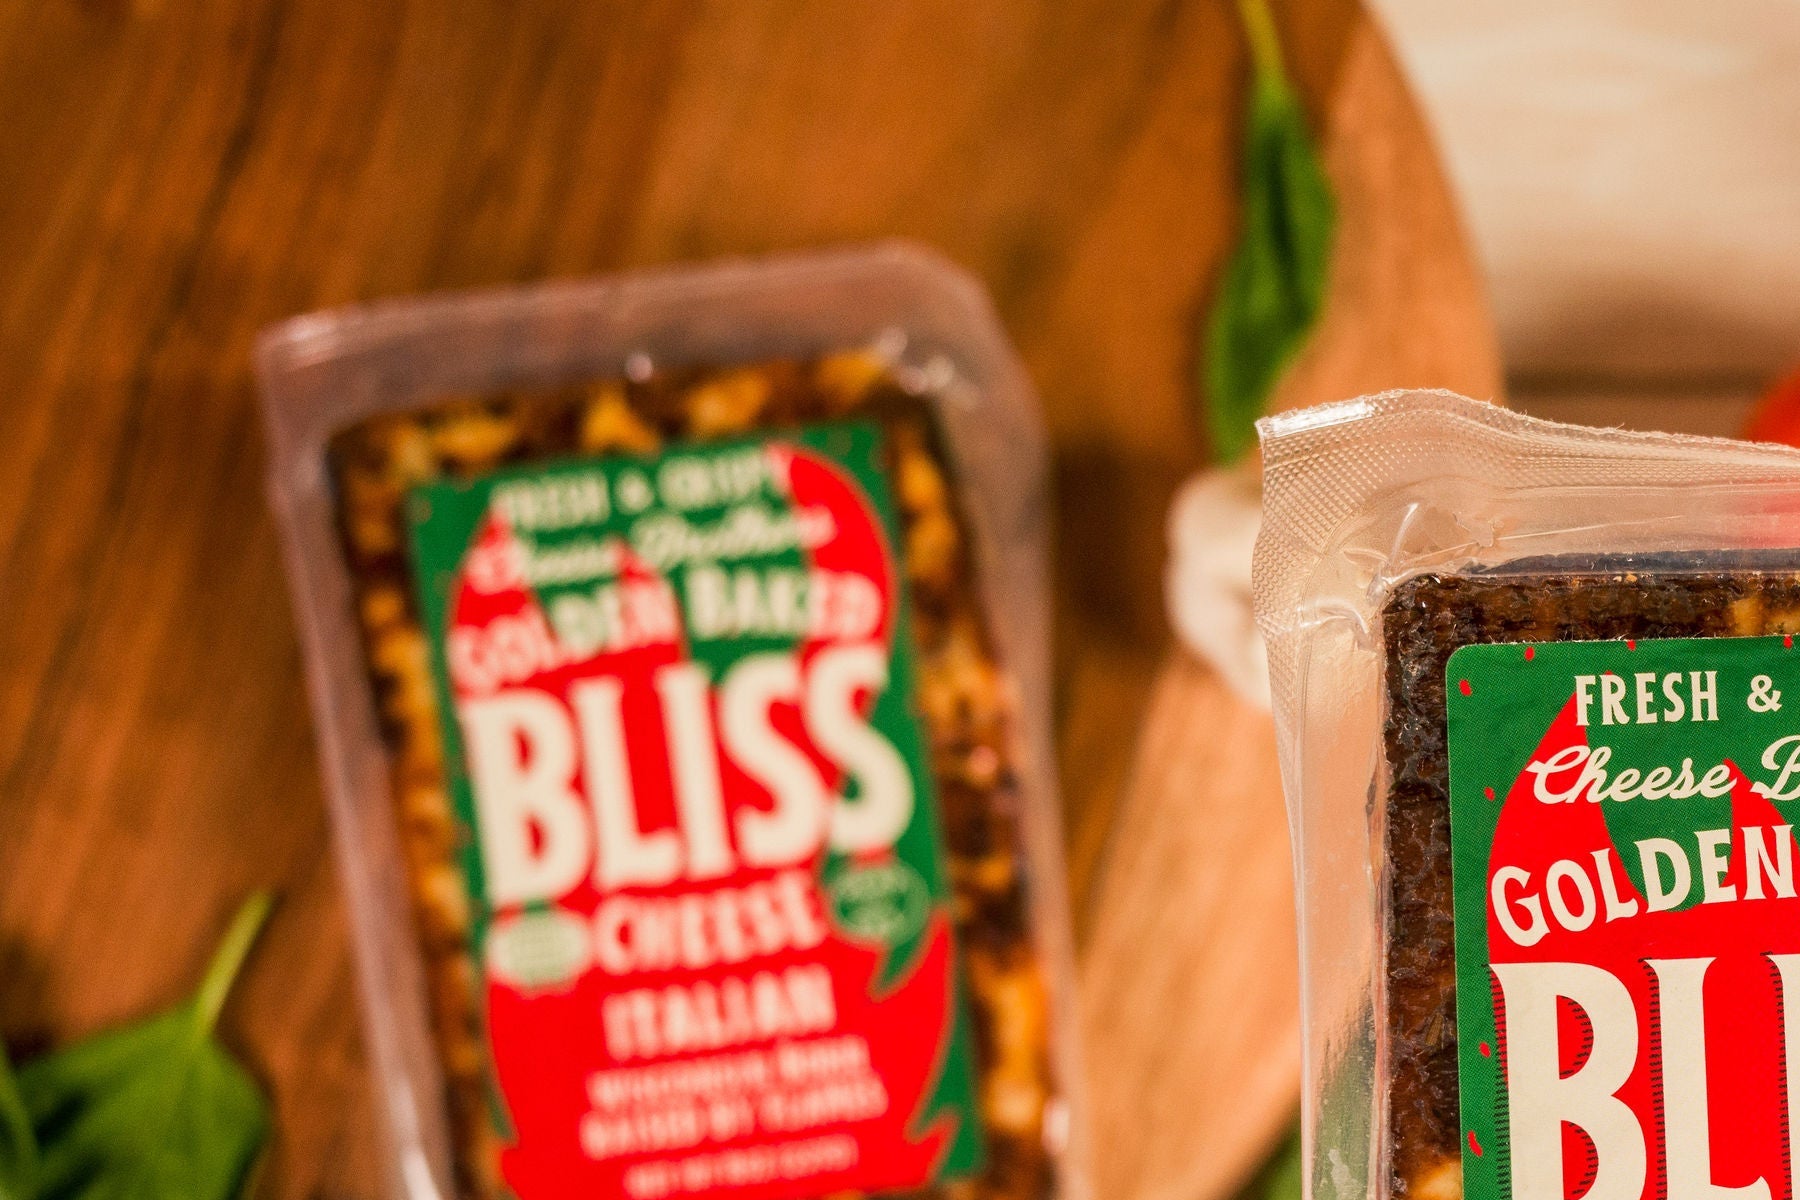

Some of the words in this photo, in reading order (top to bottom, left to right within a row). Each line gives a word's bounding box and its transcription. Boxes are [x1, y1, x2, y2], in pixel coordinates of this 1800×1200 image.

[1574, 670, 1720, 726] FRESH
[1747, 674, 1782, 713] &
[460, 640, 916, 910] BLISS
[1525, 745, 1737, 804] Cheese
[1491, 824, 1798, 947] GOLDEN
